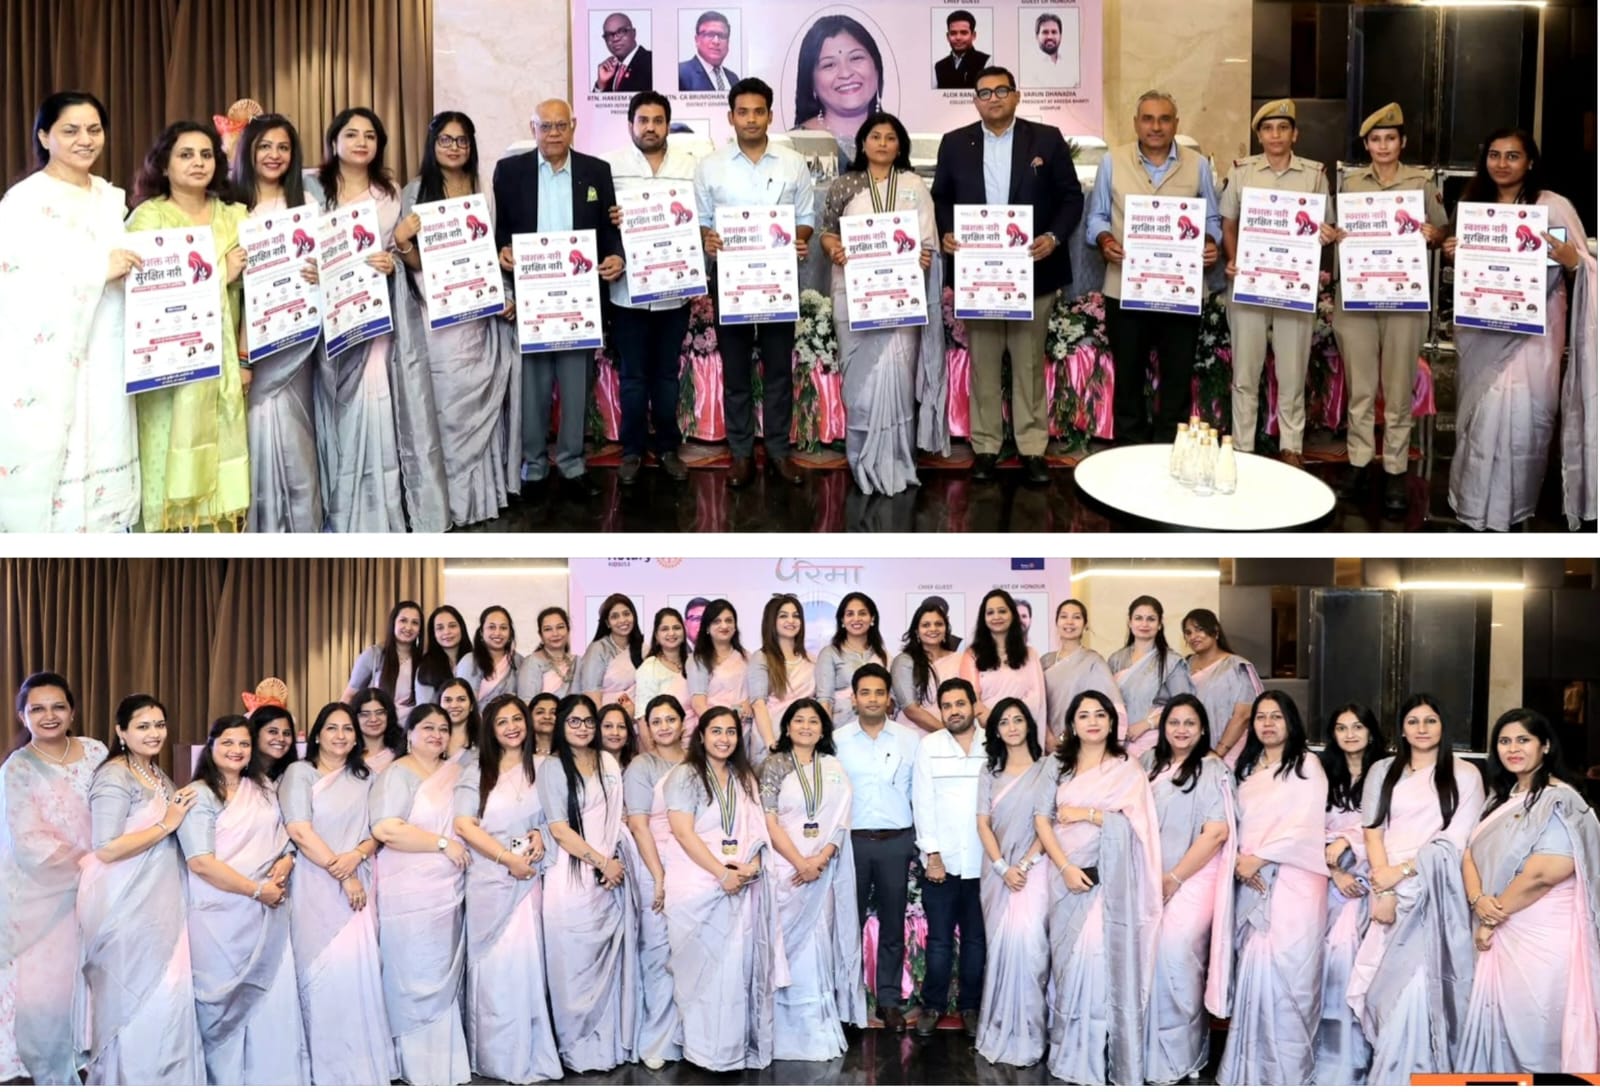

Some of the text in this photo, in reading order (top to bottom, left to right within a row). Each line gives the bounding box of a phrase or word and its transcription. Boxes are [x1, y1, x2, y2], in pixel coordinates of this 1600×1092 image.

[626, 213, 666, 228] सुरक्षित नारी
[1247, 216, 1288, 228] सुरक्षित नारी
[1345, 221, 1388, 232] सुरक्षित नारी
[1131, 223, 1171, 233] सुरक्षित नारी
[424, 232, 448, 246] सुरक्षित
[449, 228, 462, 238] नारी
[961, 232, 1000, 243] सुरक्षित नारी
[1463, 233, 1508, 244] सुरक्षित नारी
[849, 240, 888, 254] सुरक्षित नारी
[142, 257, 164, 268] शक्त
[248, 250, 271, 266] सुरक्षित
[521, 261, 563, 274] सुरक्षित नारी
[135, 265, 182, 285] सुरक्षित नारी
